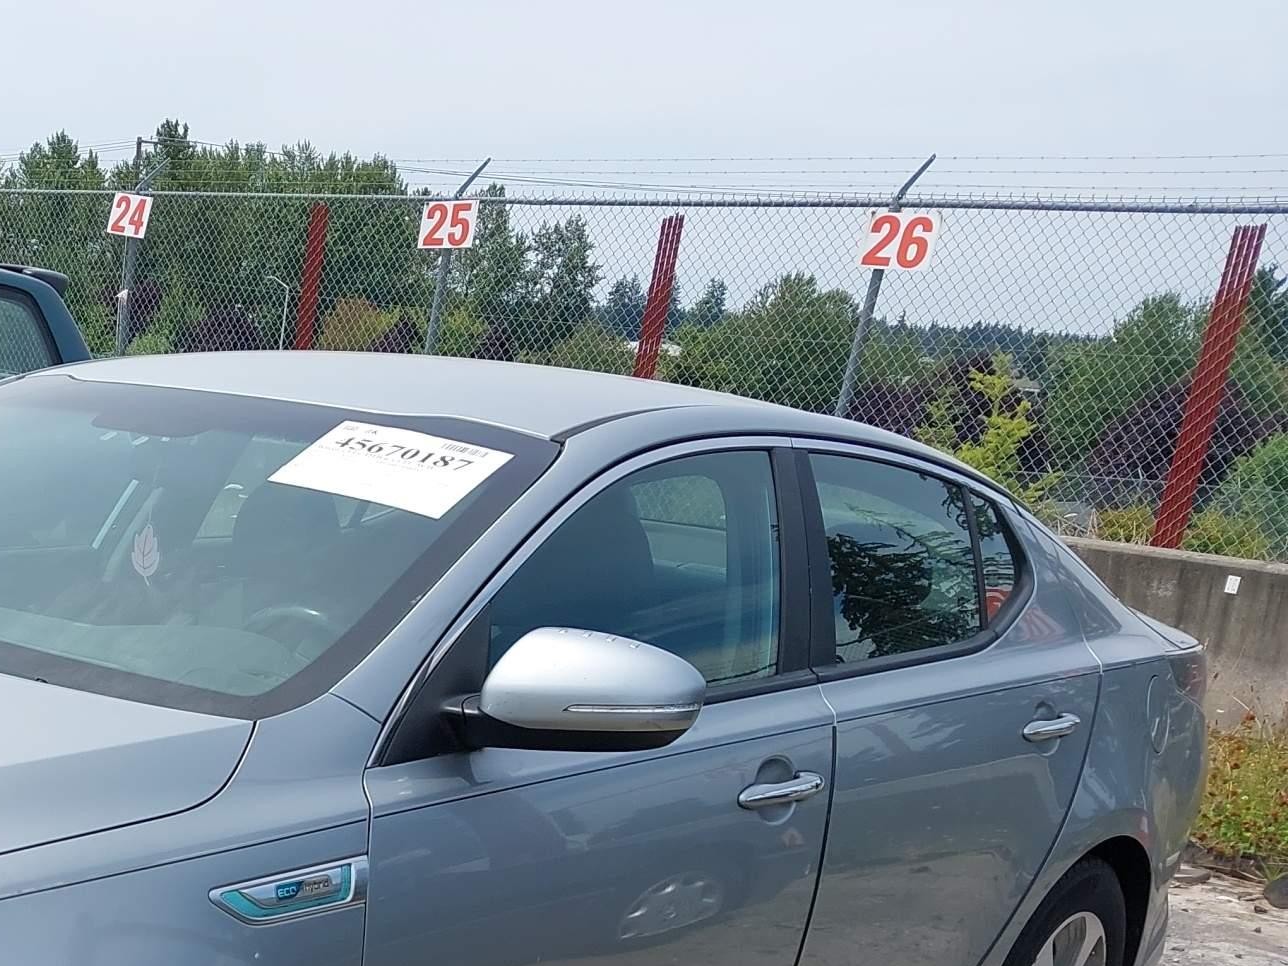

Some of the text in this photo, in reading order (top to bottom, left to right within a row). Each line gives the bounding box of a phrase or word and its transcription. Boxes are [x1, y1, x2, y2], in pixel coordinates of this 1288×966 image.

[110, 195, 148, 236] 24
[422, 203, 473, 247] 25
[860, 214, 933, 269] 26
[335, 436, 475, 471] 45670187
[277, 886, 297, 898] ECO
